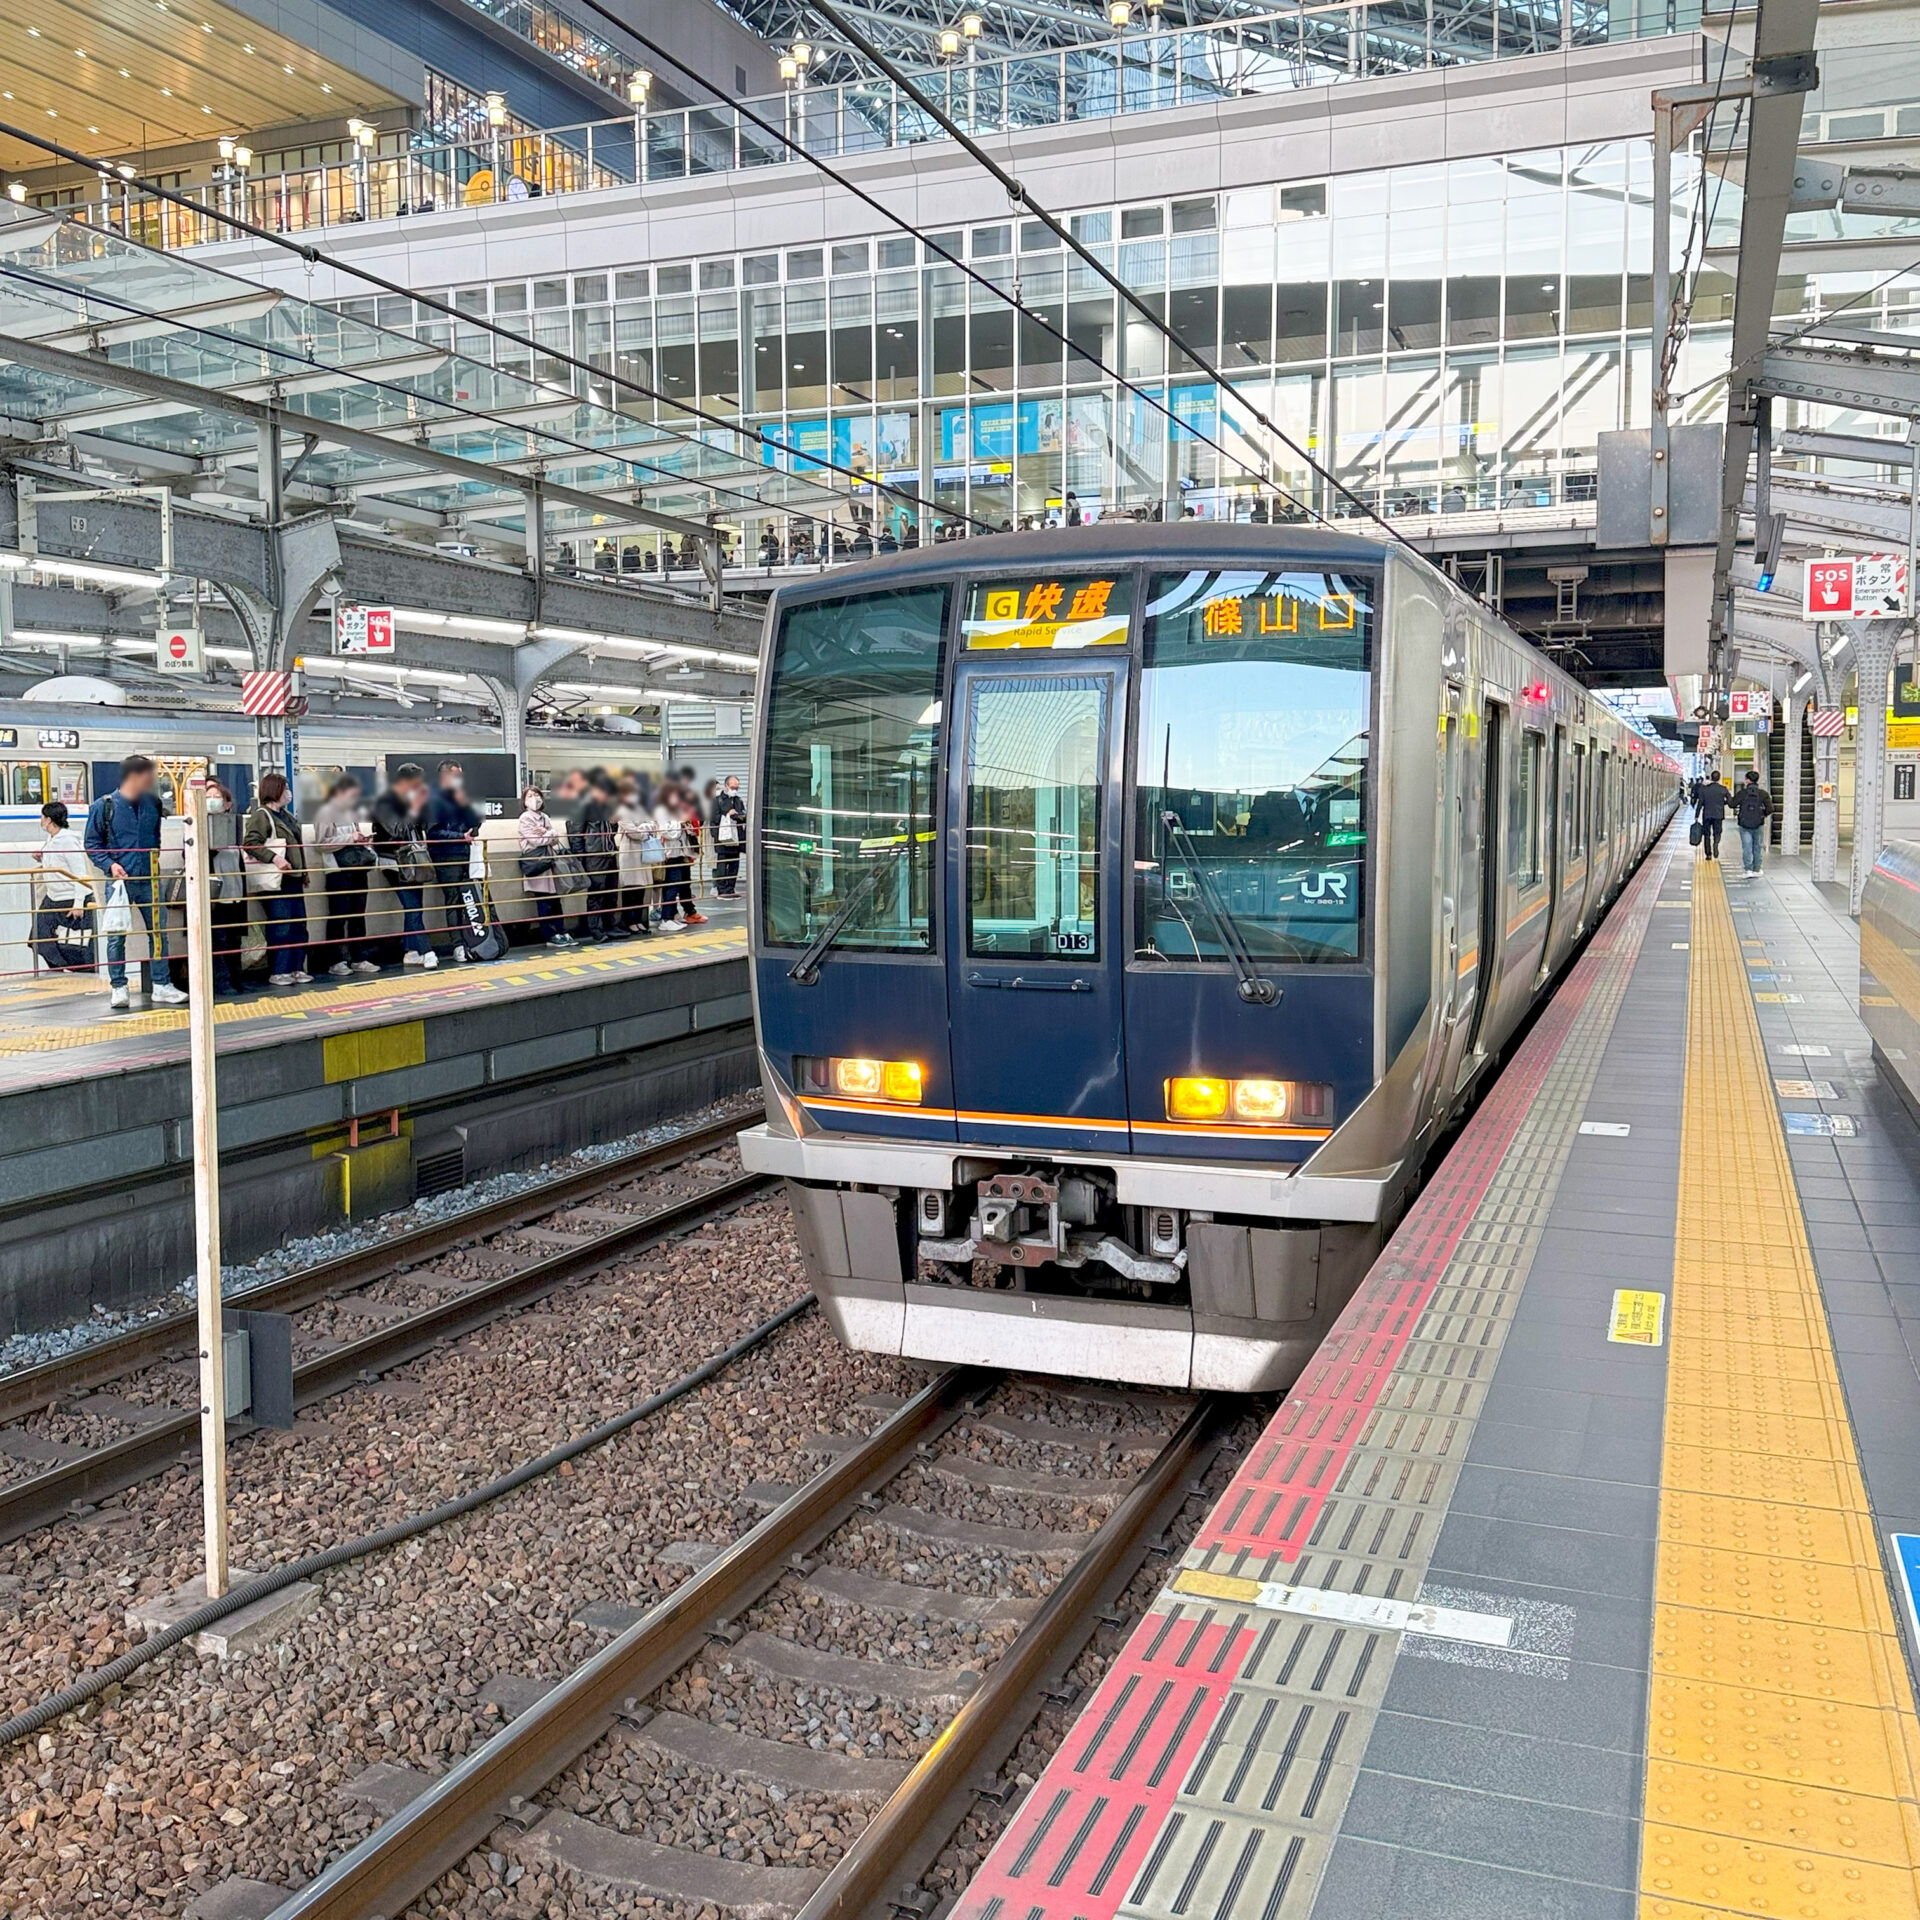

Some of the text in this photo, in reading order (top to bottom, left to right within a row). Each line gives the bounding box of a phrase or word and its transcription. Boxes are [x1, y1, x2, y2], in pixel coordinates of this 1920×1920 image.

[1814, 569, 1848, 582] SOS
[1856, 563, 1891, 574] 非常
[1855, 575, 1891, 586] ボタン
[993, 596, 1011, 617] G
[1023, 580, 1116, 621] 快速
[369, 615, 389, 626] SOS
[1203, 593, 1355, 636] 篠山口
[1013, 626, 1042, 638] Rapid
[1300, 872, 1348, 898] JR
[1057, 934, 1088, 949] D13
